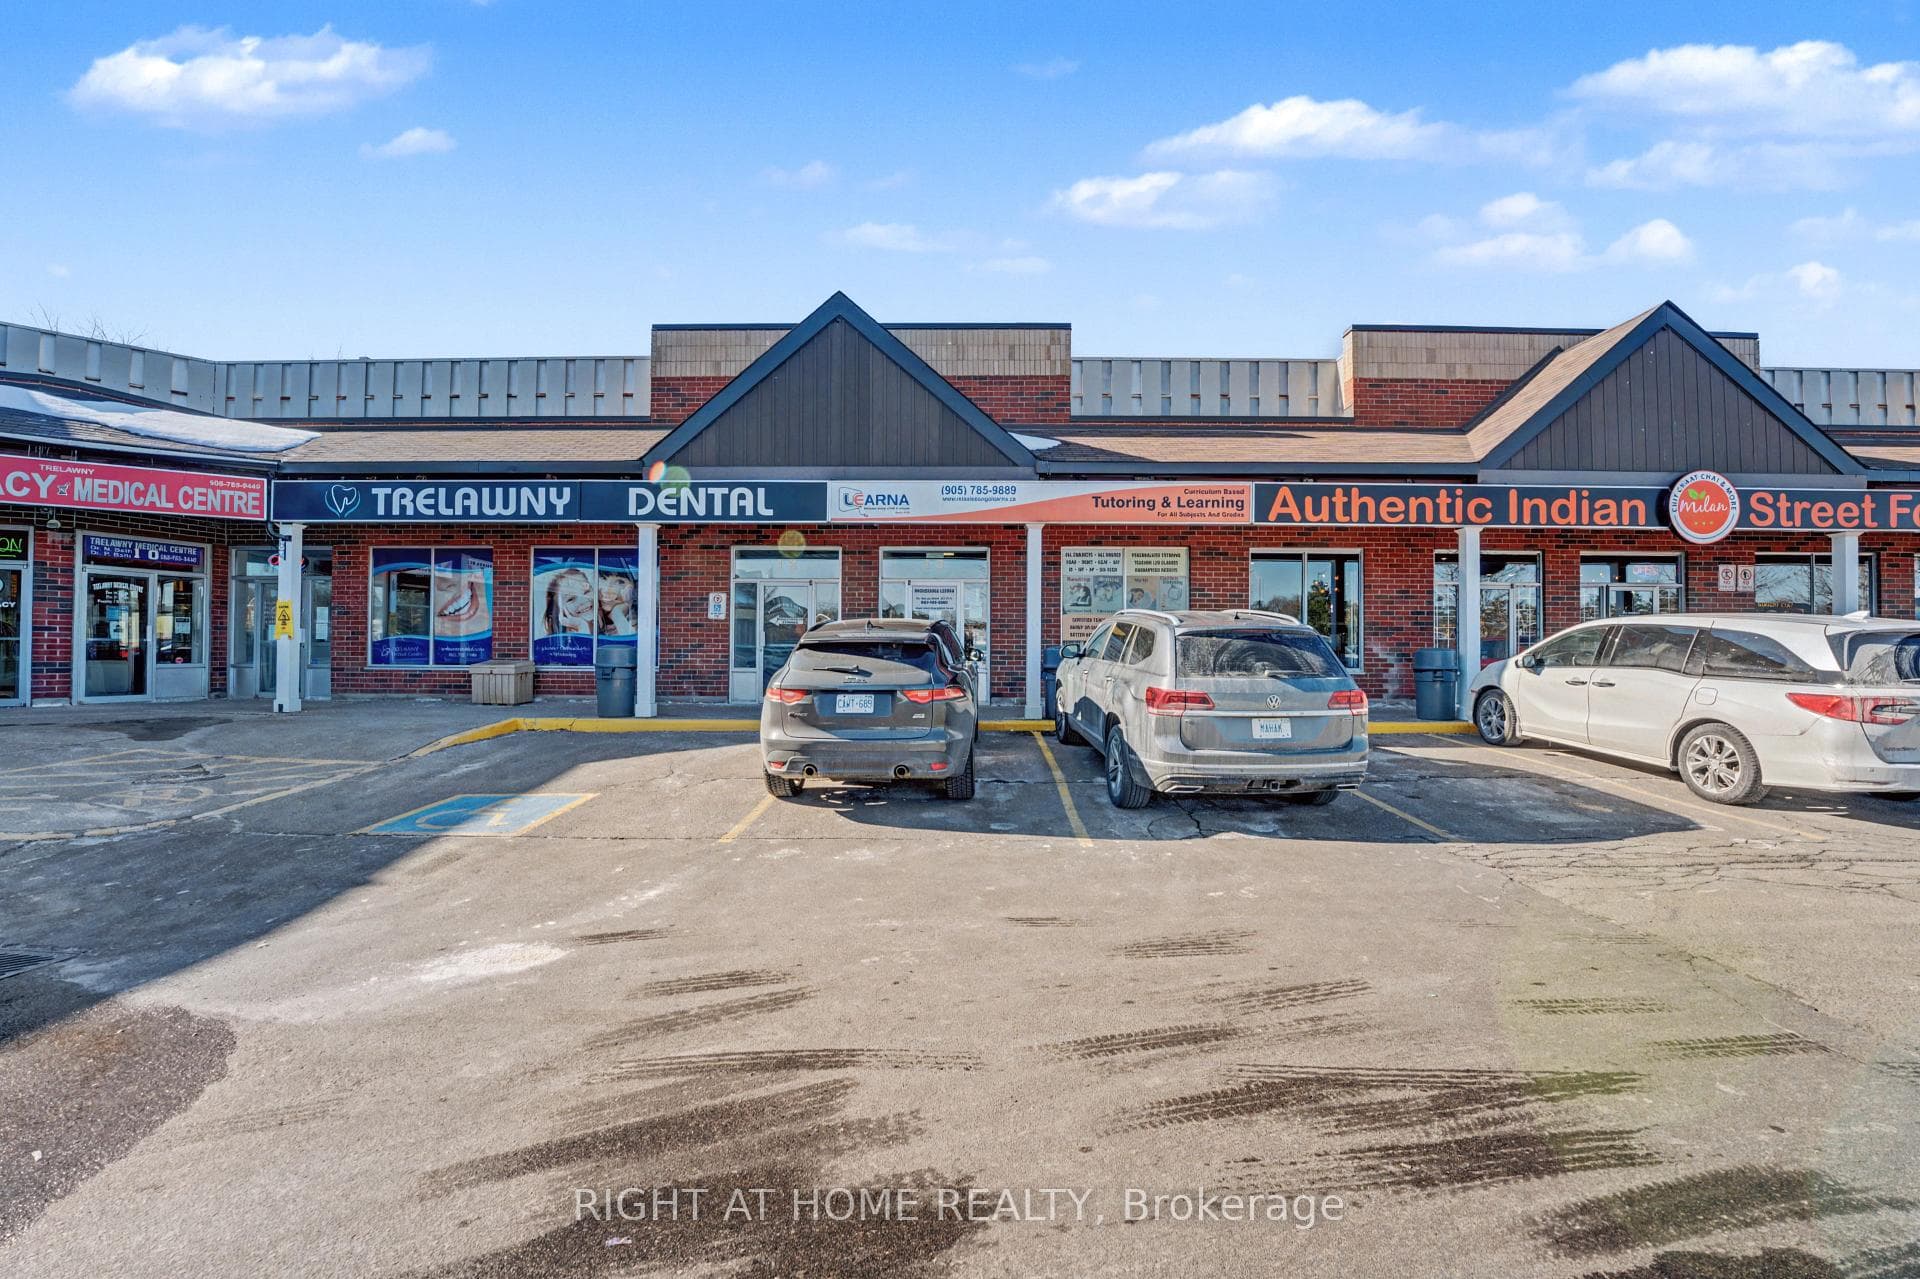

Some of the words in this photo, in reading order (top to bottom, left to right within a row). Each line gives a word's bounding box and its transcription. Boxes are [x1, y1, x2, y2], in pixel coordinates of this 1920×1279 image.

[39, 464, 95, 475] TRELAWNY
[0, 471, 56, 499] CY
[73, 477, 174, 510] MEDICAL
[178, 486, 260, 514] CENTRE
[371, 487, 571, 516] TRELAWNY
[628, 487, 773, 516] DENTAL
[941, 485, 967, 496] (905)
[970, 485, 1017, 495] 785-9889
[1700, 473, 1720, 482] CHAI
[1726, 487, 1737, 510] MORE
[1092, 496, 1156, 511] Tutoring
[1161, 496, 1171, 509] &
[1178, 496, 1245, 511] Learning
[1179, 511, 1206, 519] Subjects
[1267, 486, 1493, 524] Authentic
[1508, 488, 1646, 526] Indian
[1749, 491, 1878, 528] Street
[90, 537, 133, 548] TRELAWNY
[135, 541, 167, 553] MEDICAL
[169, 546, 197, 555] CENTRE
